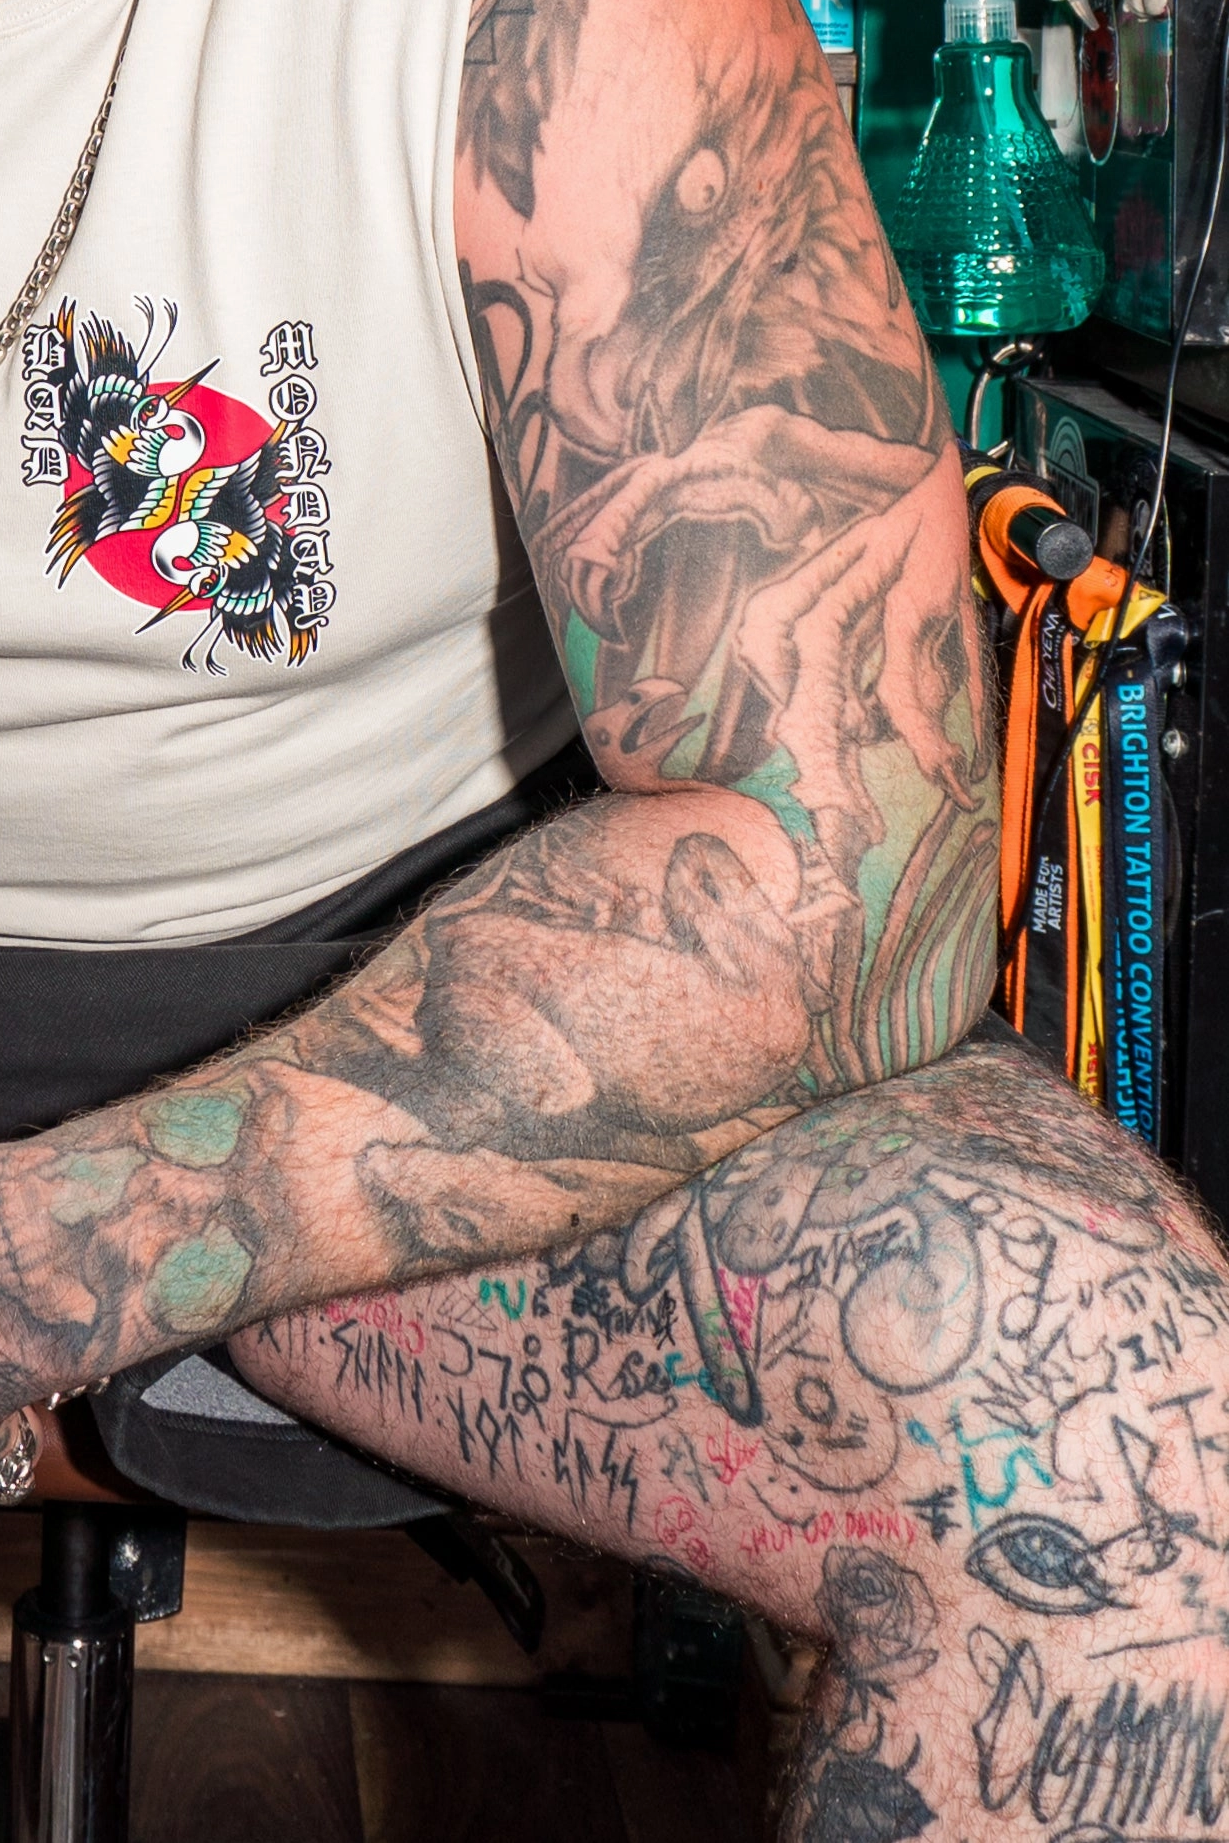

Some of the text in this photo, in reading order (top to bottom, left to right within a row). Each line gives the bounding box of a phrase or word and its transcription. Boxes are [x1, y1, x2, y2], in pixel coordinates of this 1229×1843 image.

[21, 322, 70, 487] BAD
[260, 319, 337, 631] MONDAY
[1032, 887, 1049, 934] MADE
[1047, 863, 1064, 931] ARTISTS
[1117, 684, 1154, 1143] BRIGHTON TATTOO CONVENTIO
